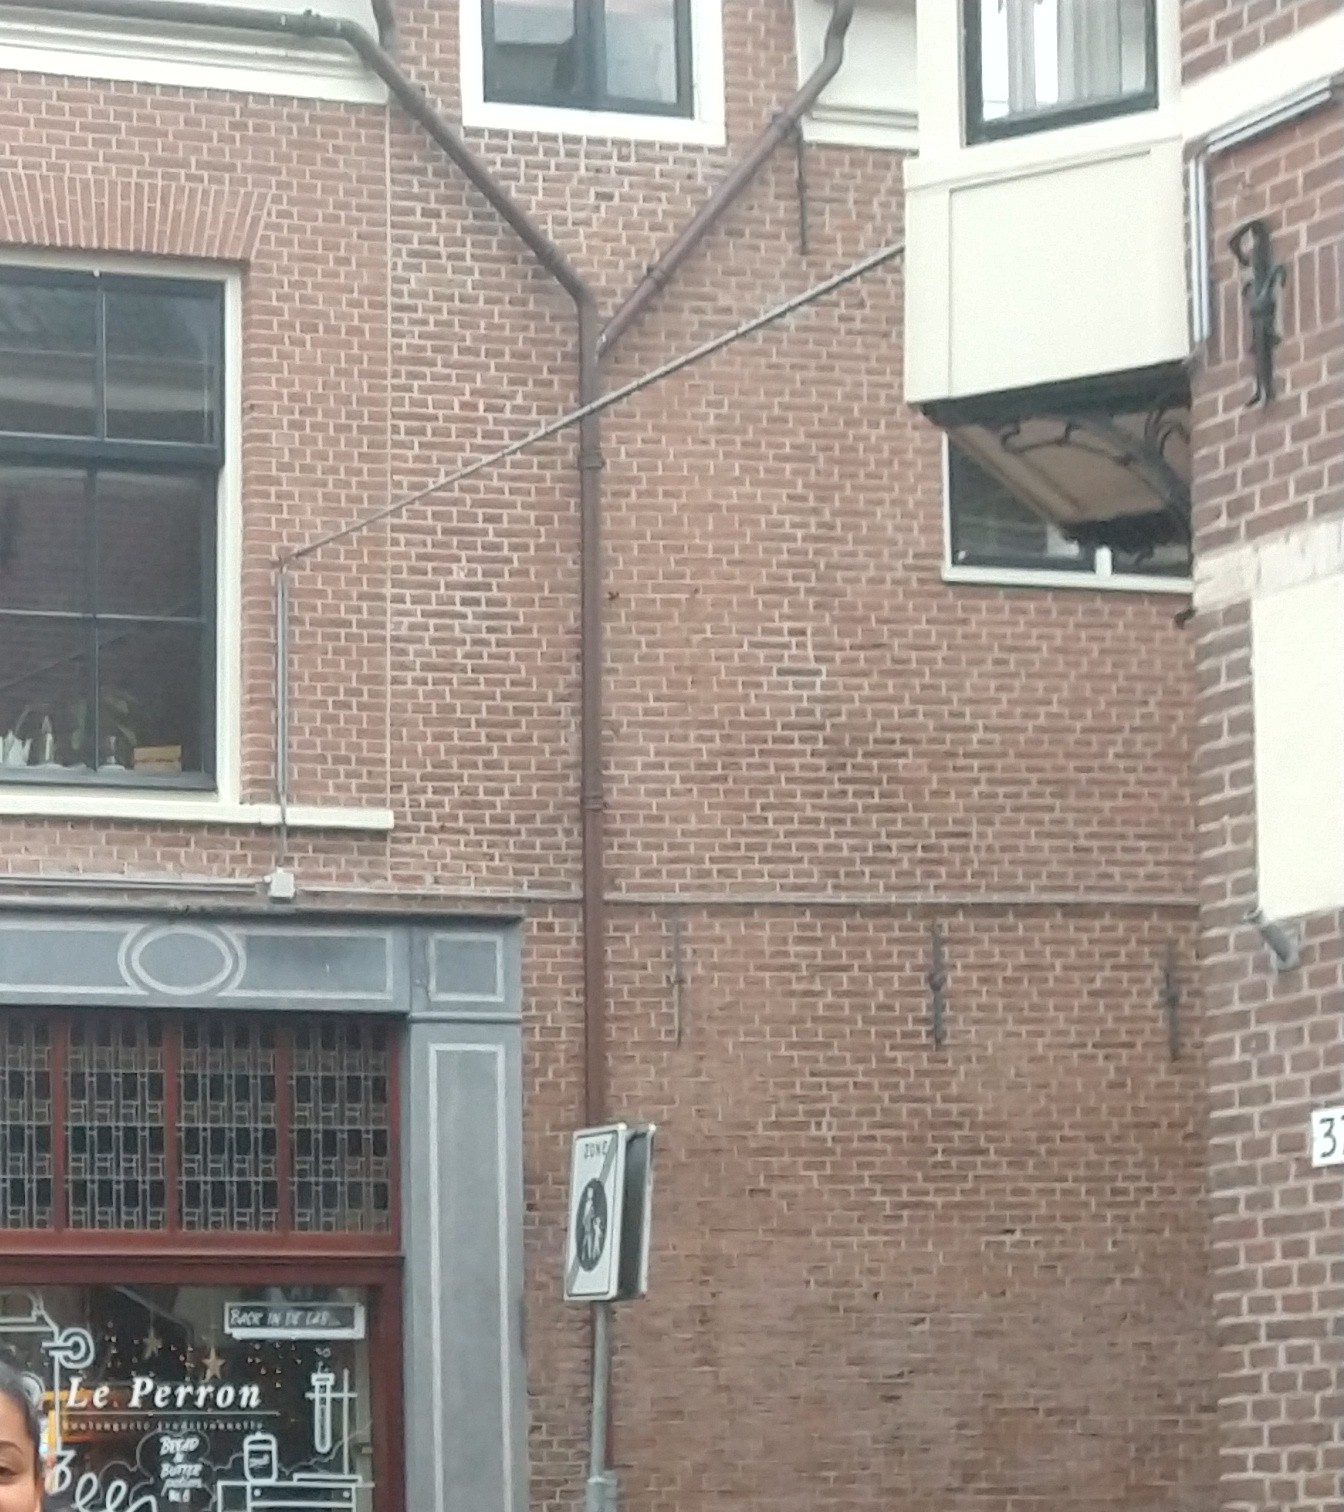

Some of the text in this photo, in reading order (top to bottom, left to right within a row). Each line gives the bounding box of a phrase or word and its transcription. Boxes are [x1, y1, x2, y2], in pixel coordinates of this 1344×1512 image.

[1319, 1115, 1344, 1158] 3
[66, 1376, 262, 1409] Le Perron
